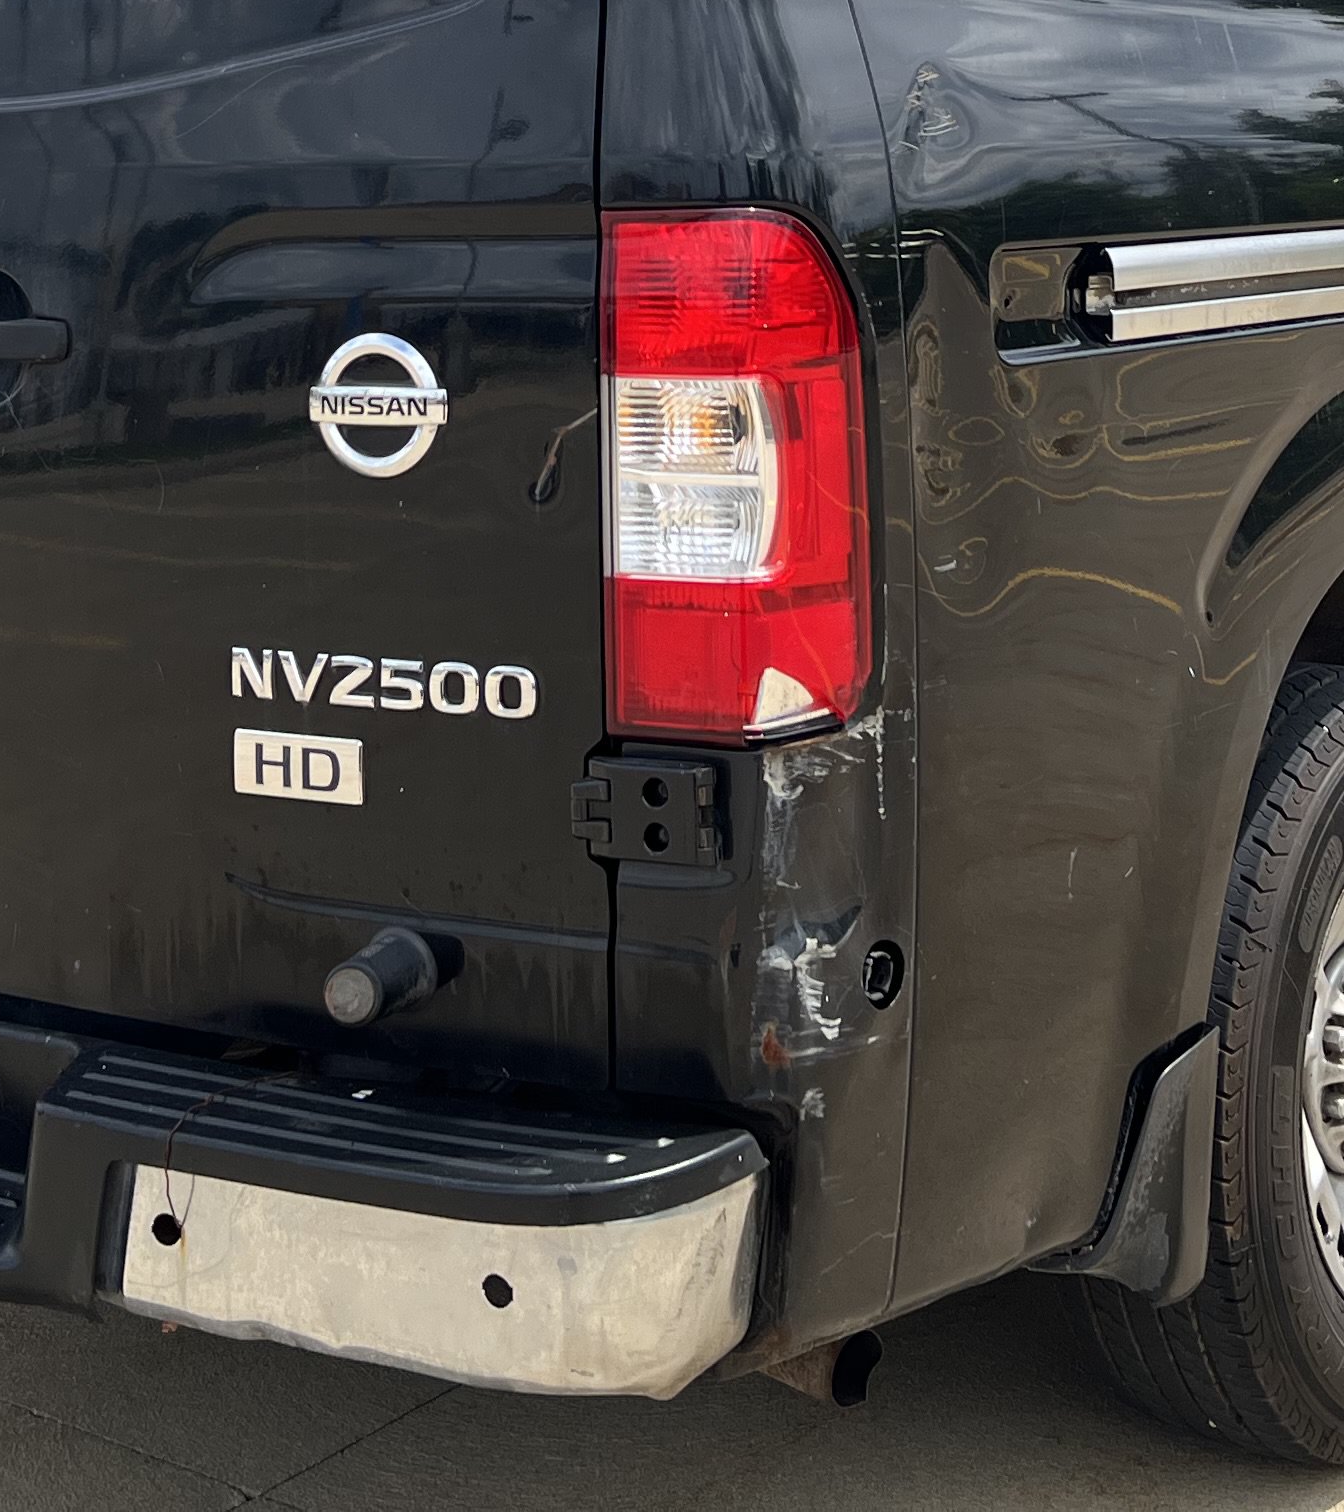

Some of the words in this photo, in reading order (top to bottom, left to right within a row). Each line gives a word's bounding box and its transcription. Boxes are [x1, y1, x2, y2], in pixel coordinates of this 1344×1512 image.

[320, 394, 429, 417] NISSAN
[230, 646, 538, 720] NV2500
[254, 741, 342, 793] HD
